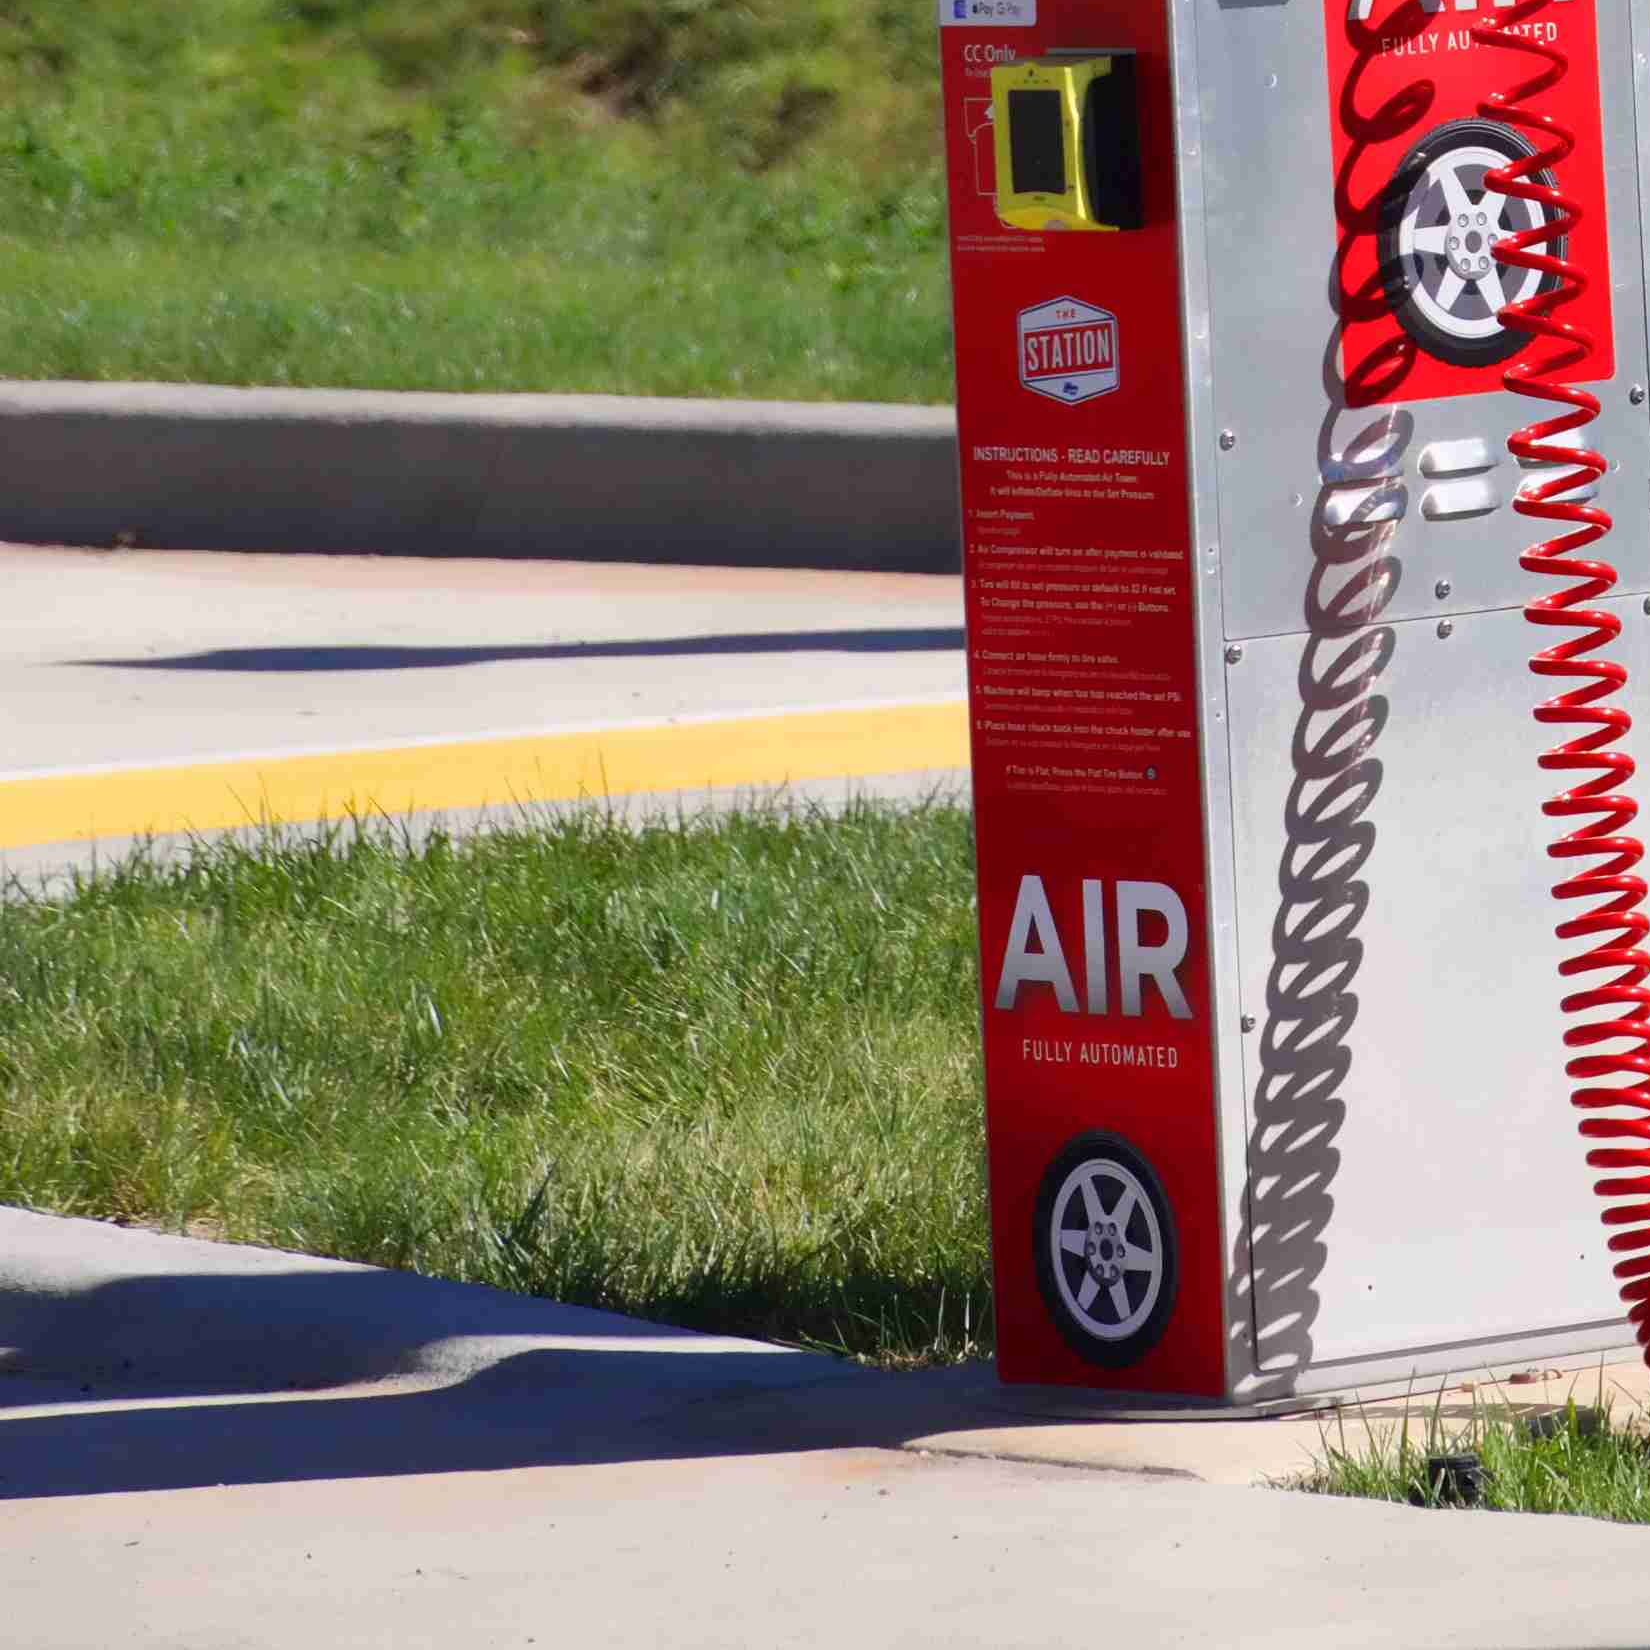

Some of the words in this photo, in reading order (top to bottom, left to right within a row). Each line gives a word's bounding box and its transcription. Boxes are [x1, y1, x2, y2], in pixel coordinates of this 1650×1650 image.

[1381, 32, 1439, 57] FULLY
[1056, 308, 1078, 320] THE
[1027, 327, 1110, 371] STATION
[974, 445, 1058, 462] INSTRUCTIONS
[1067, 447, 1101, 464] READ
[1103, 449, 1170, 466] CAREFULLY
[993, 874, 1194, 1019] AIR
[1023, 1038, 1073, 1062] FULLY
[1080, 1042, 1178, 1068] AUTOMATED
